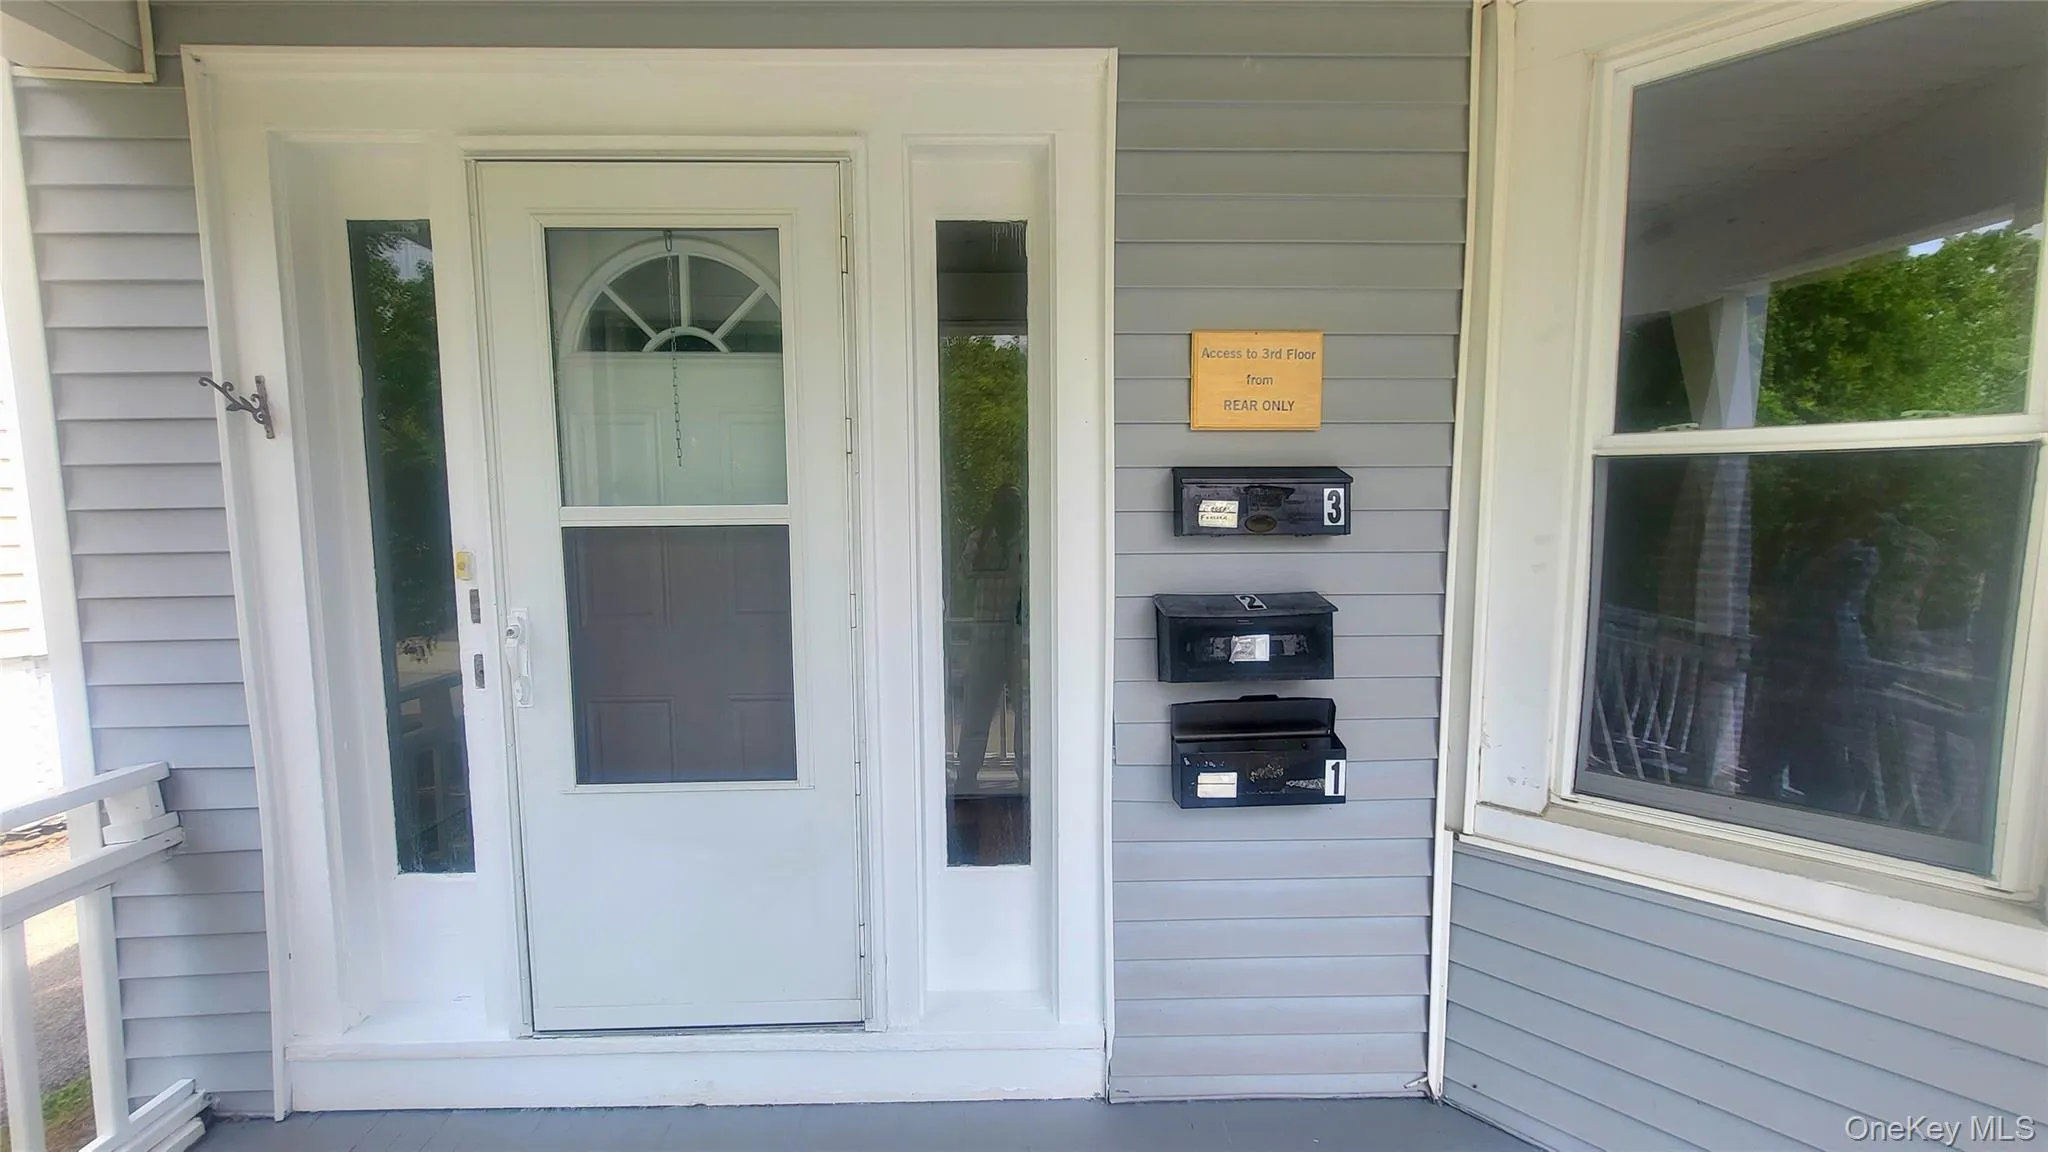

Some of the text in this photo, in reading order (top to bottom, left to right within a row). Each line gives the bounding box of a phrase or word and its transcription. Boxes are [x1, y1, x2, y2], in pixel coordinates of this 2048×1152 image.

[1201, 347, 1317, 360] Access to 3rd Floor
[1246, 374, 1274, 386] from
[1223, 399, 1296, 412] REAR ONLY
[1327, 489, 1342, 524] 3
[1239, 595, 1264, 610] 2
[1331, 761, 1341, 795] 1
